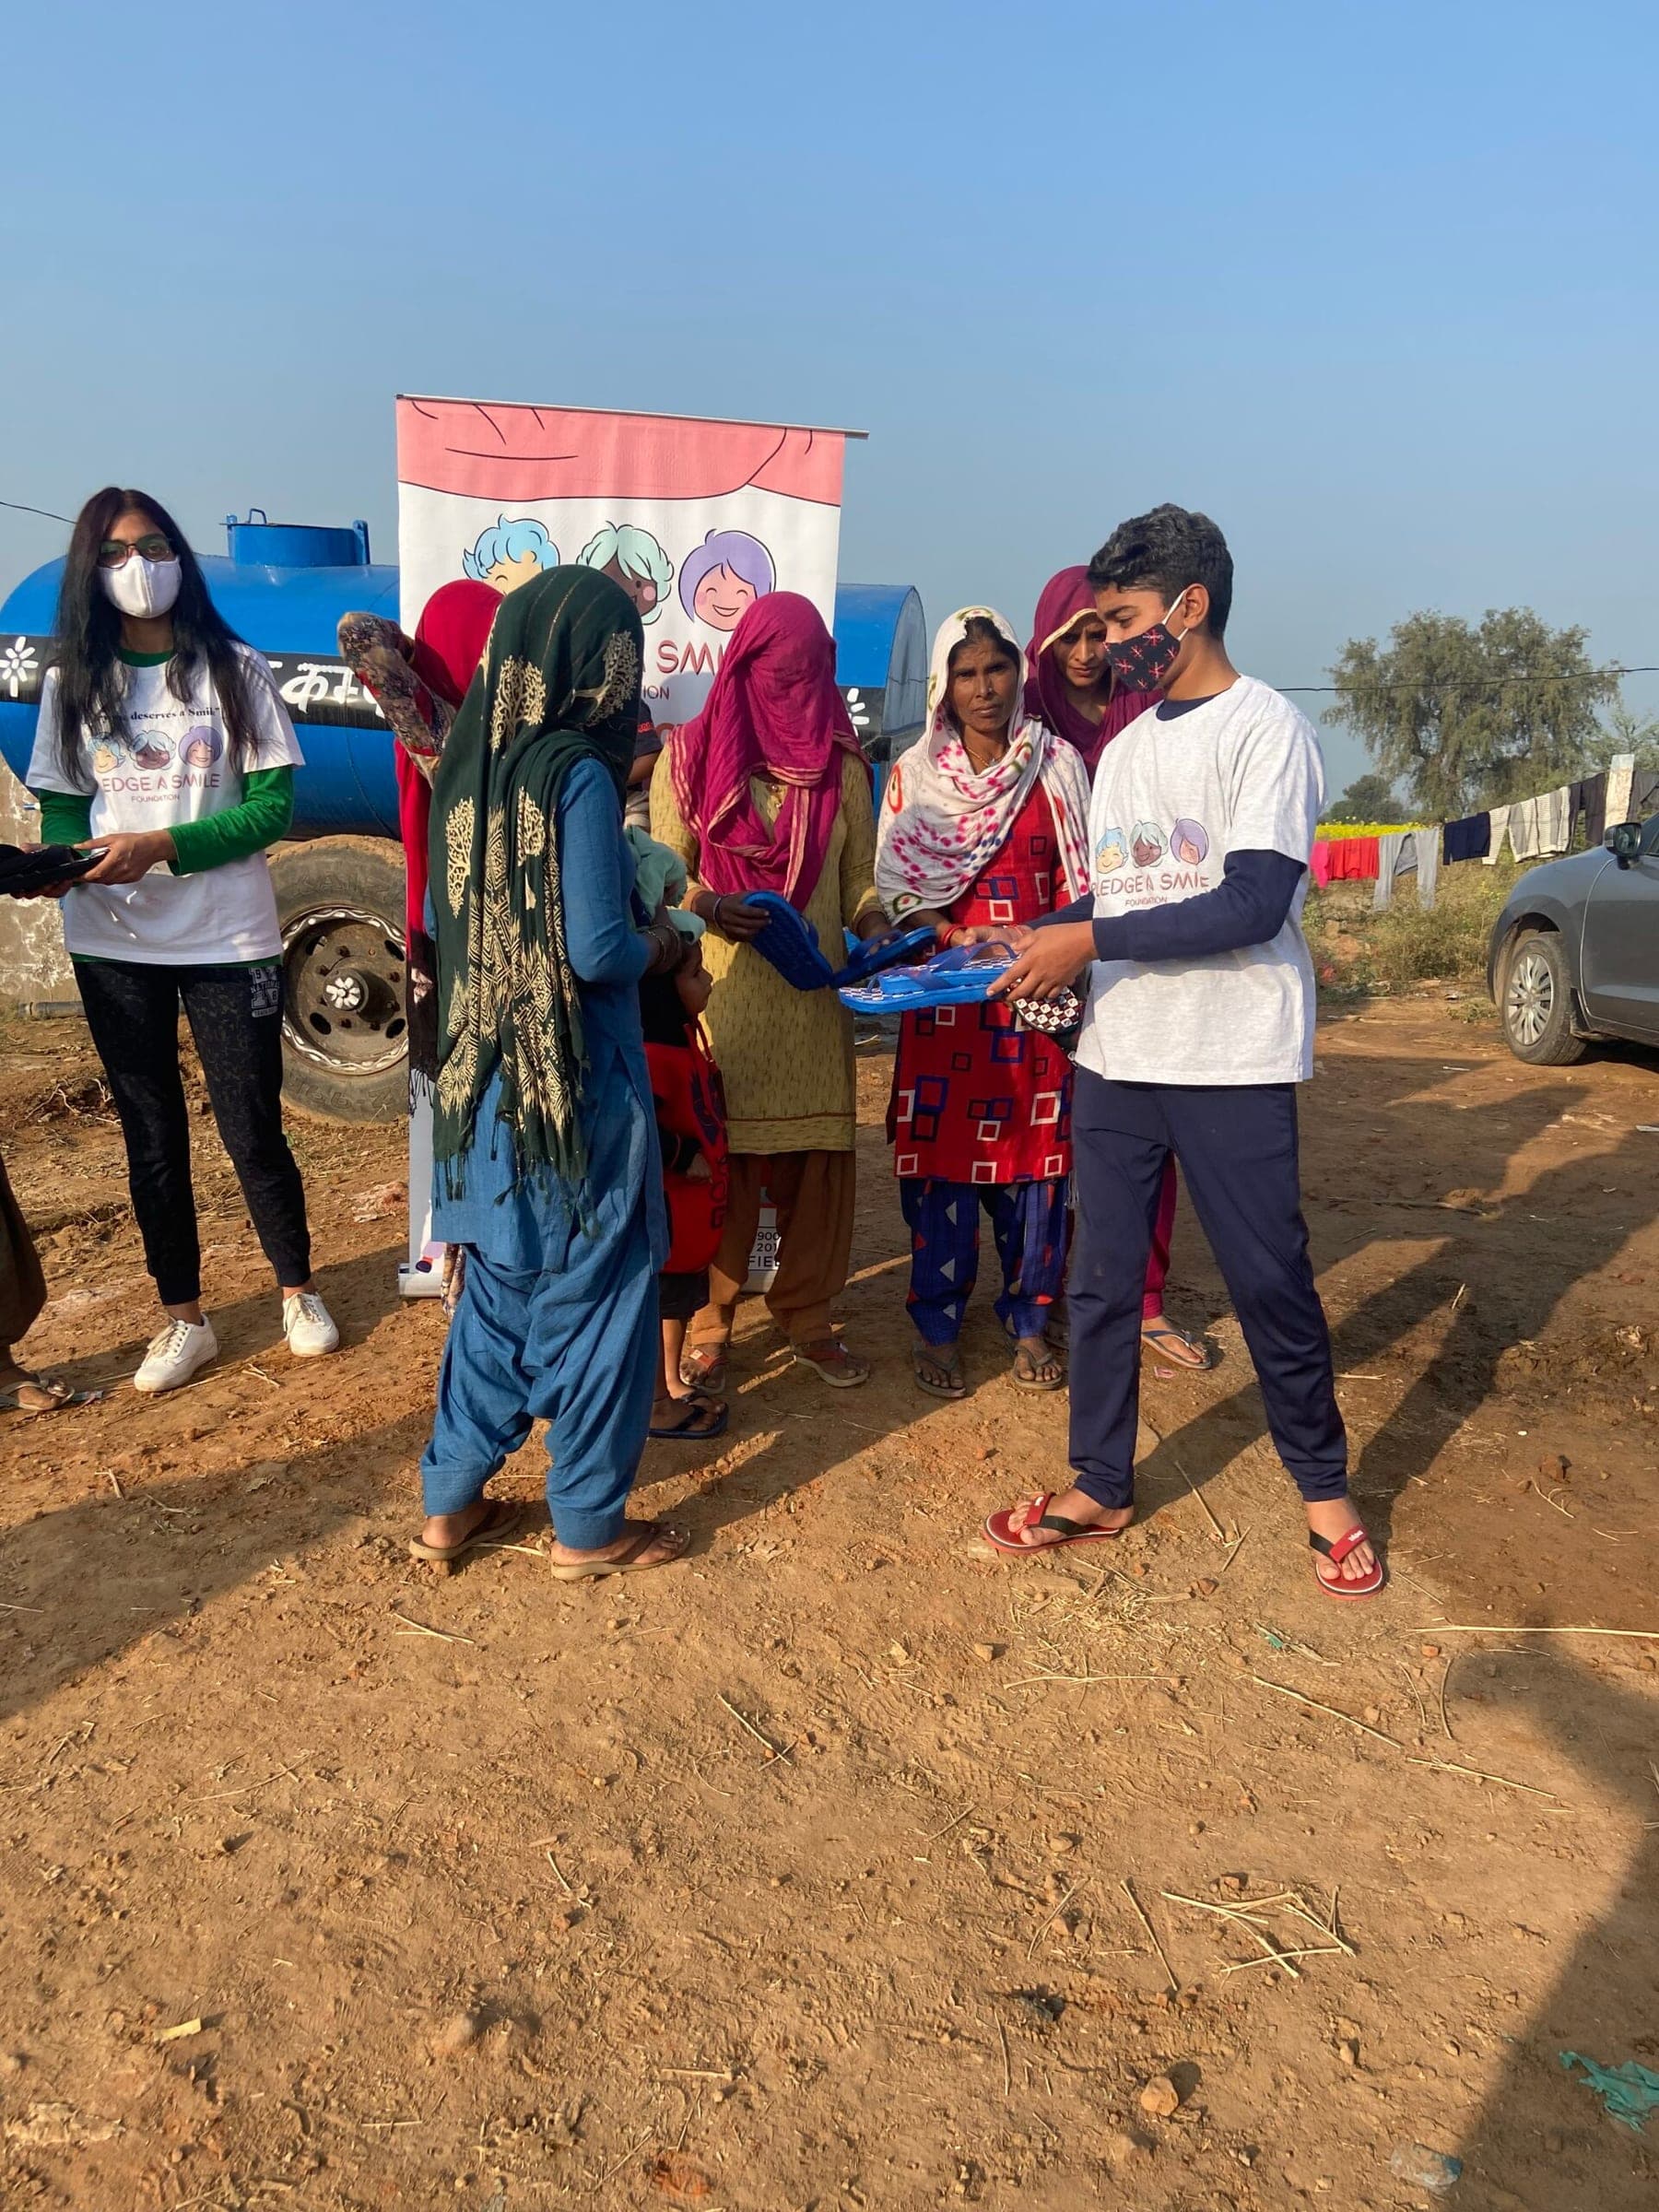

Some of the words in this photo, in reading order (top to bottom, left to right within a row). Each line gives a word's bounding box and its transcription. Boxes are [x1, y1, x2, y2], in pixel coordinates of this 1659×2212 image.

[656, 640, 725, 676] SMI
[643, 685, 670, 700] ION
[131, 711, 176, 721] deserves
[158, 775, 168, 790] A
[171, 773, 221, 789] SMILE
[131, 794, 181, 803] FOUNDATION
[1146, 874, 1155, 891] A
[758, 1231, 780, 1241] 900
[757, 1243, 777, 1253] 201
[747, 1255, 776, 1267] FIE
